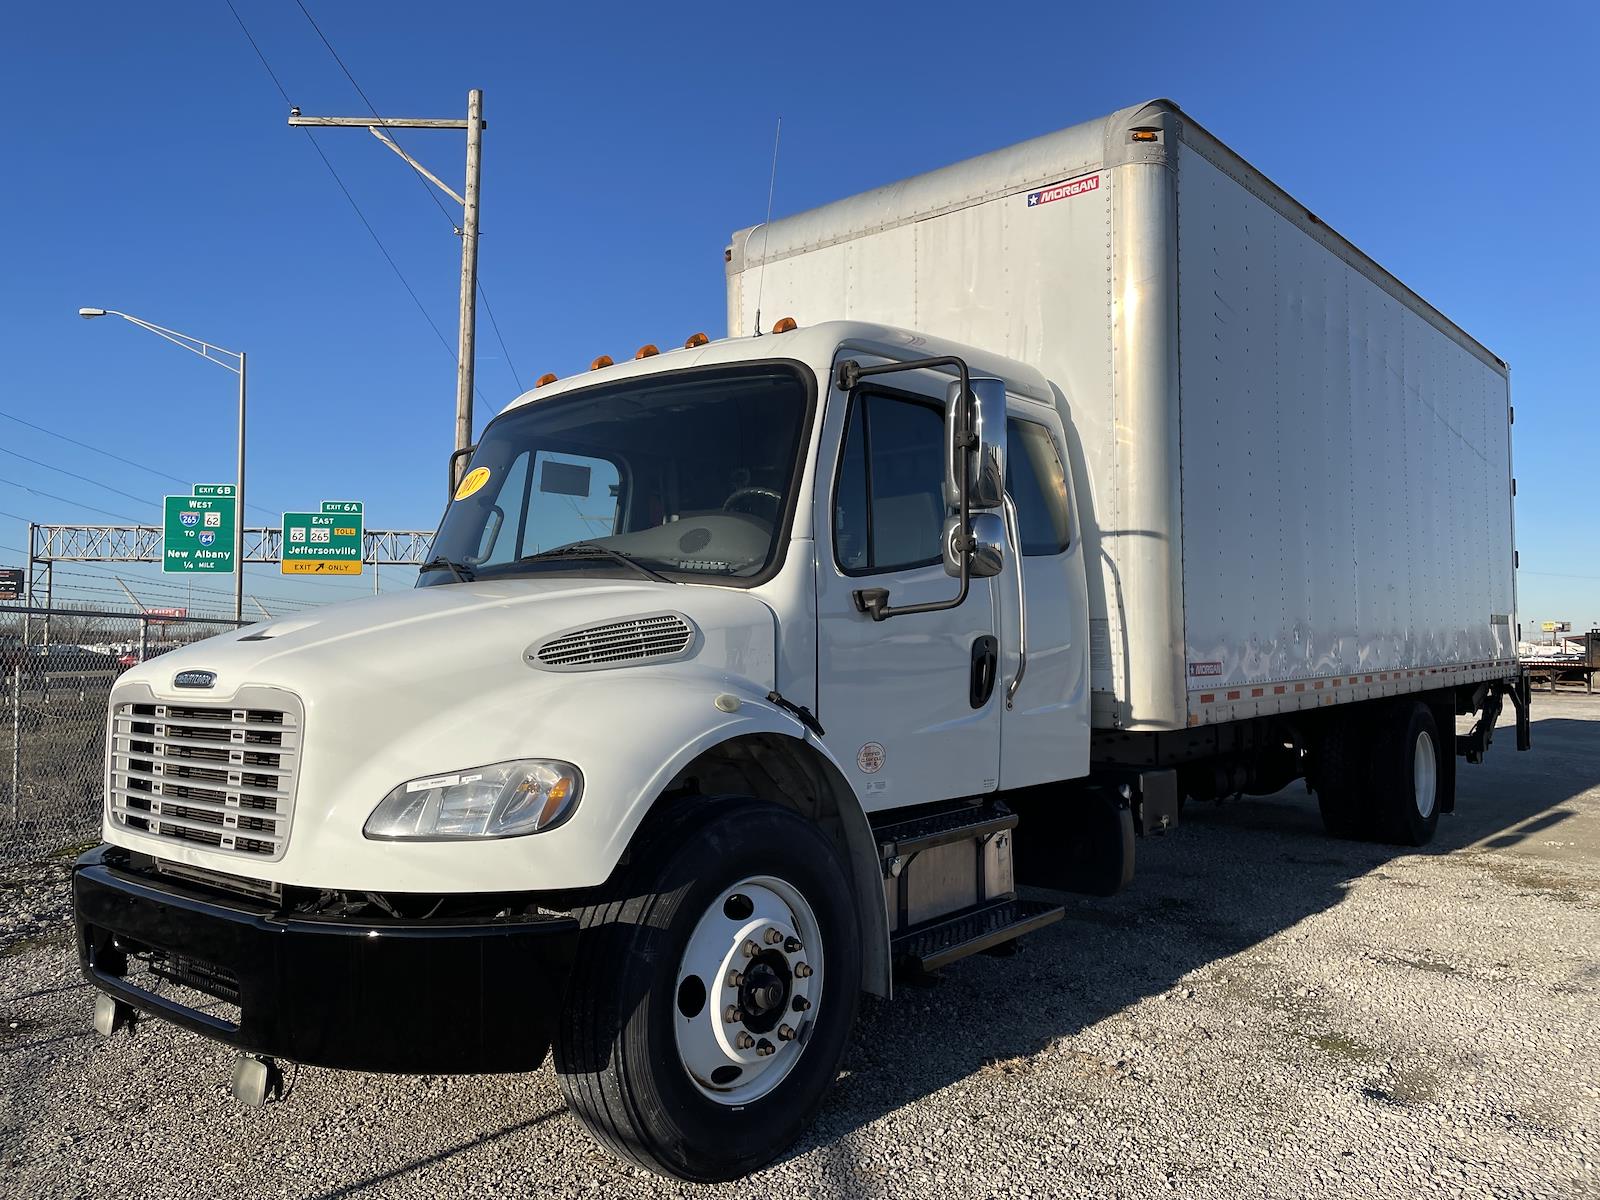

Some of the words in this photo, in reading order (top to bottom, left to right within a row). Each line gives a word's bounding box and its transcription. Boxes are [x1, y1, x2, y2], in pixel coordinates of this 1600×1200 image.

[1040, 178, 1098, 203] MORGAN
[217, 486, 231, 494] 6B
[189, 500, 212, 508] WEST
[182, 515, 197, 524] 265
[206, 517, 219, 525] 62
[312, 516, 334, 525] EAST
[291, 532, 304, 541] 62
[311, 532, 329, 541] 265
[167, 549, 188, 558] New
[194, 549, 231, 560] Albany
[288, 546, 356, 555] Jeffersonville
[1196, 664, 1221, 675] MORGAN
